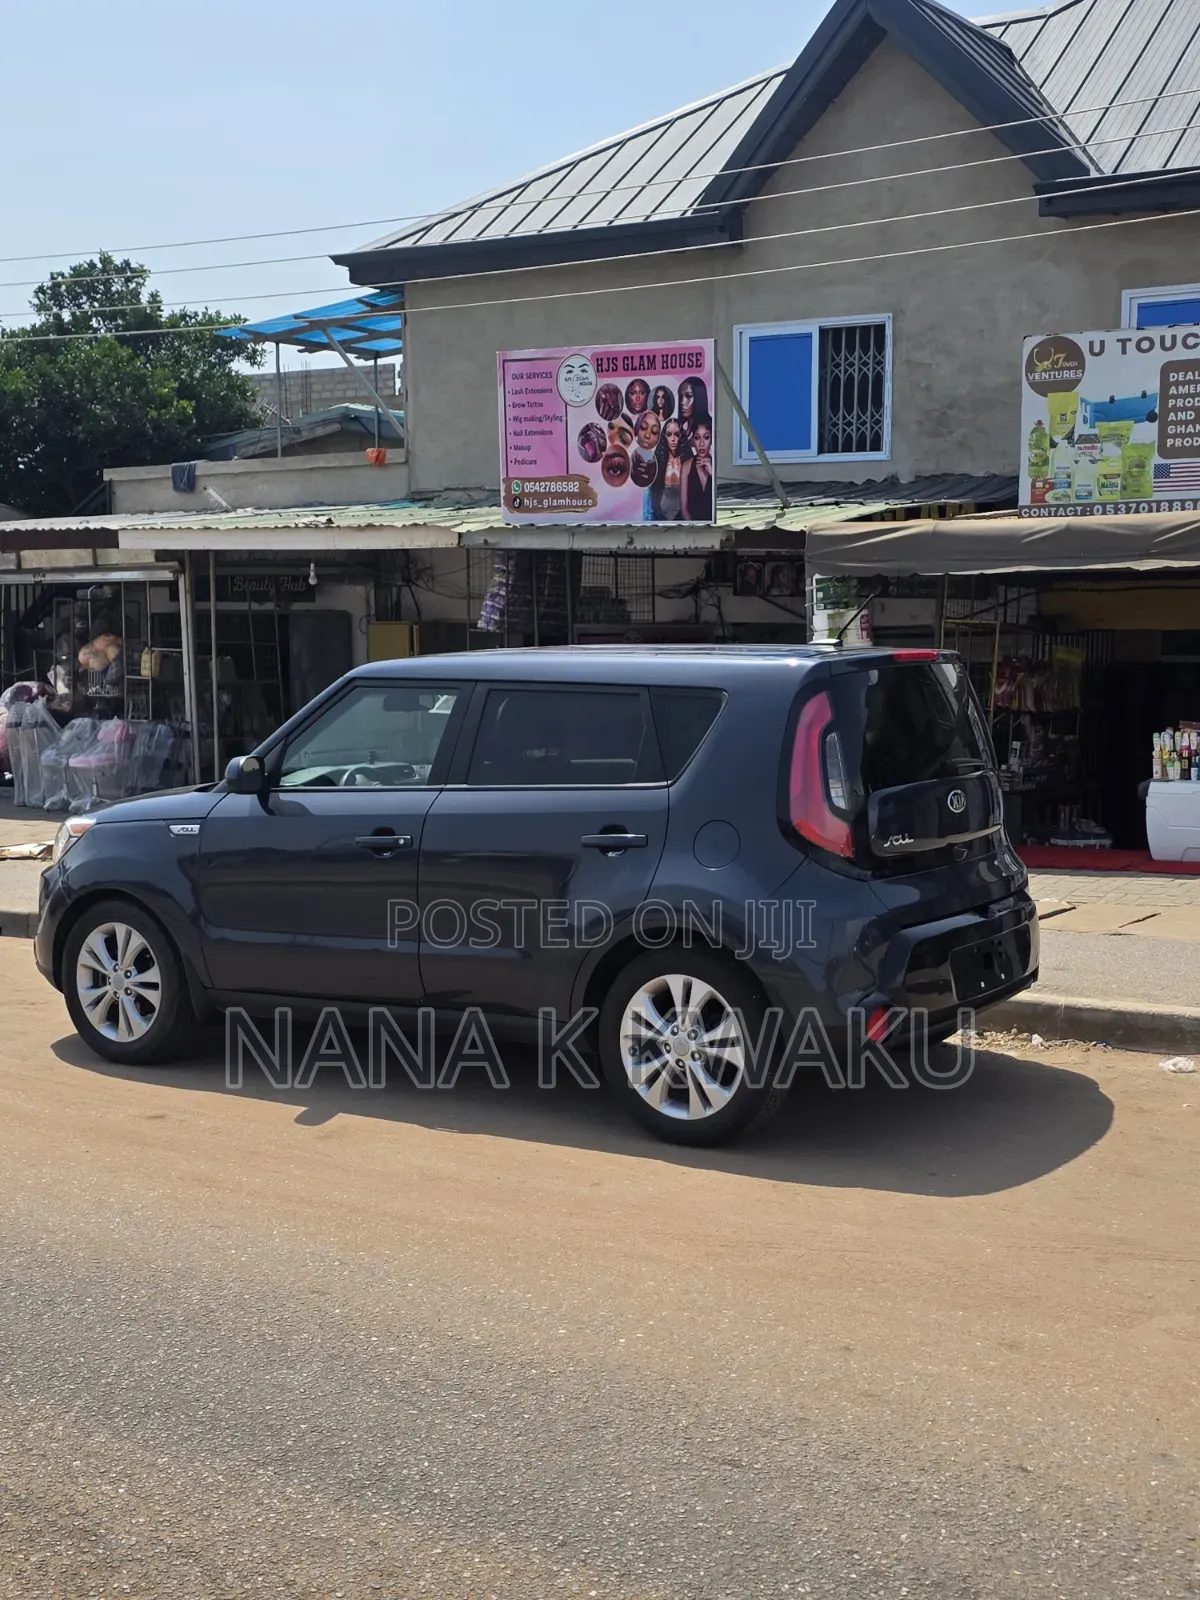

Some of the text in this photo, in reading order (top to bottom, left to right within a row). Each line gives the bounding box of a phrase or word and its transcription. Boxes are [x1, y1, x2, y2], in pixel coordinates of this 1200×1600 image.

[1089, 339, 1106, 358] U
[596, 352, 702, 373] HJS GLAM HOUSE
[525, 371, 553, 380] SERVICES
[1028, 369, 1083, 381] VENTURES
[524, 387, 553, 395] Extensions
[1167, 411, 1196, 422] AND
[513, 429, 523, 437] Nail
[1166, 437, 1200, 448] PROD
[524, 482, 579, 493] 0542786582
[524, 497, 593, 509] hjs_glamhouse
[279, 576, 306, 592] Hub
